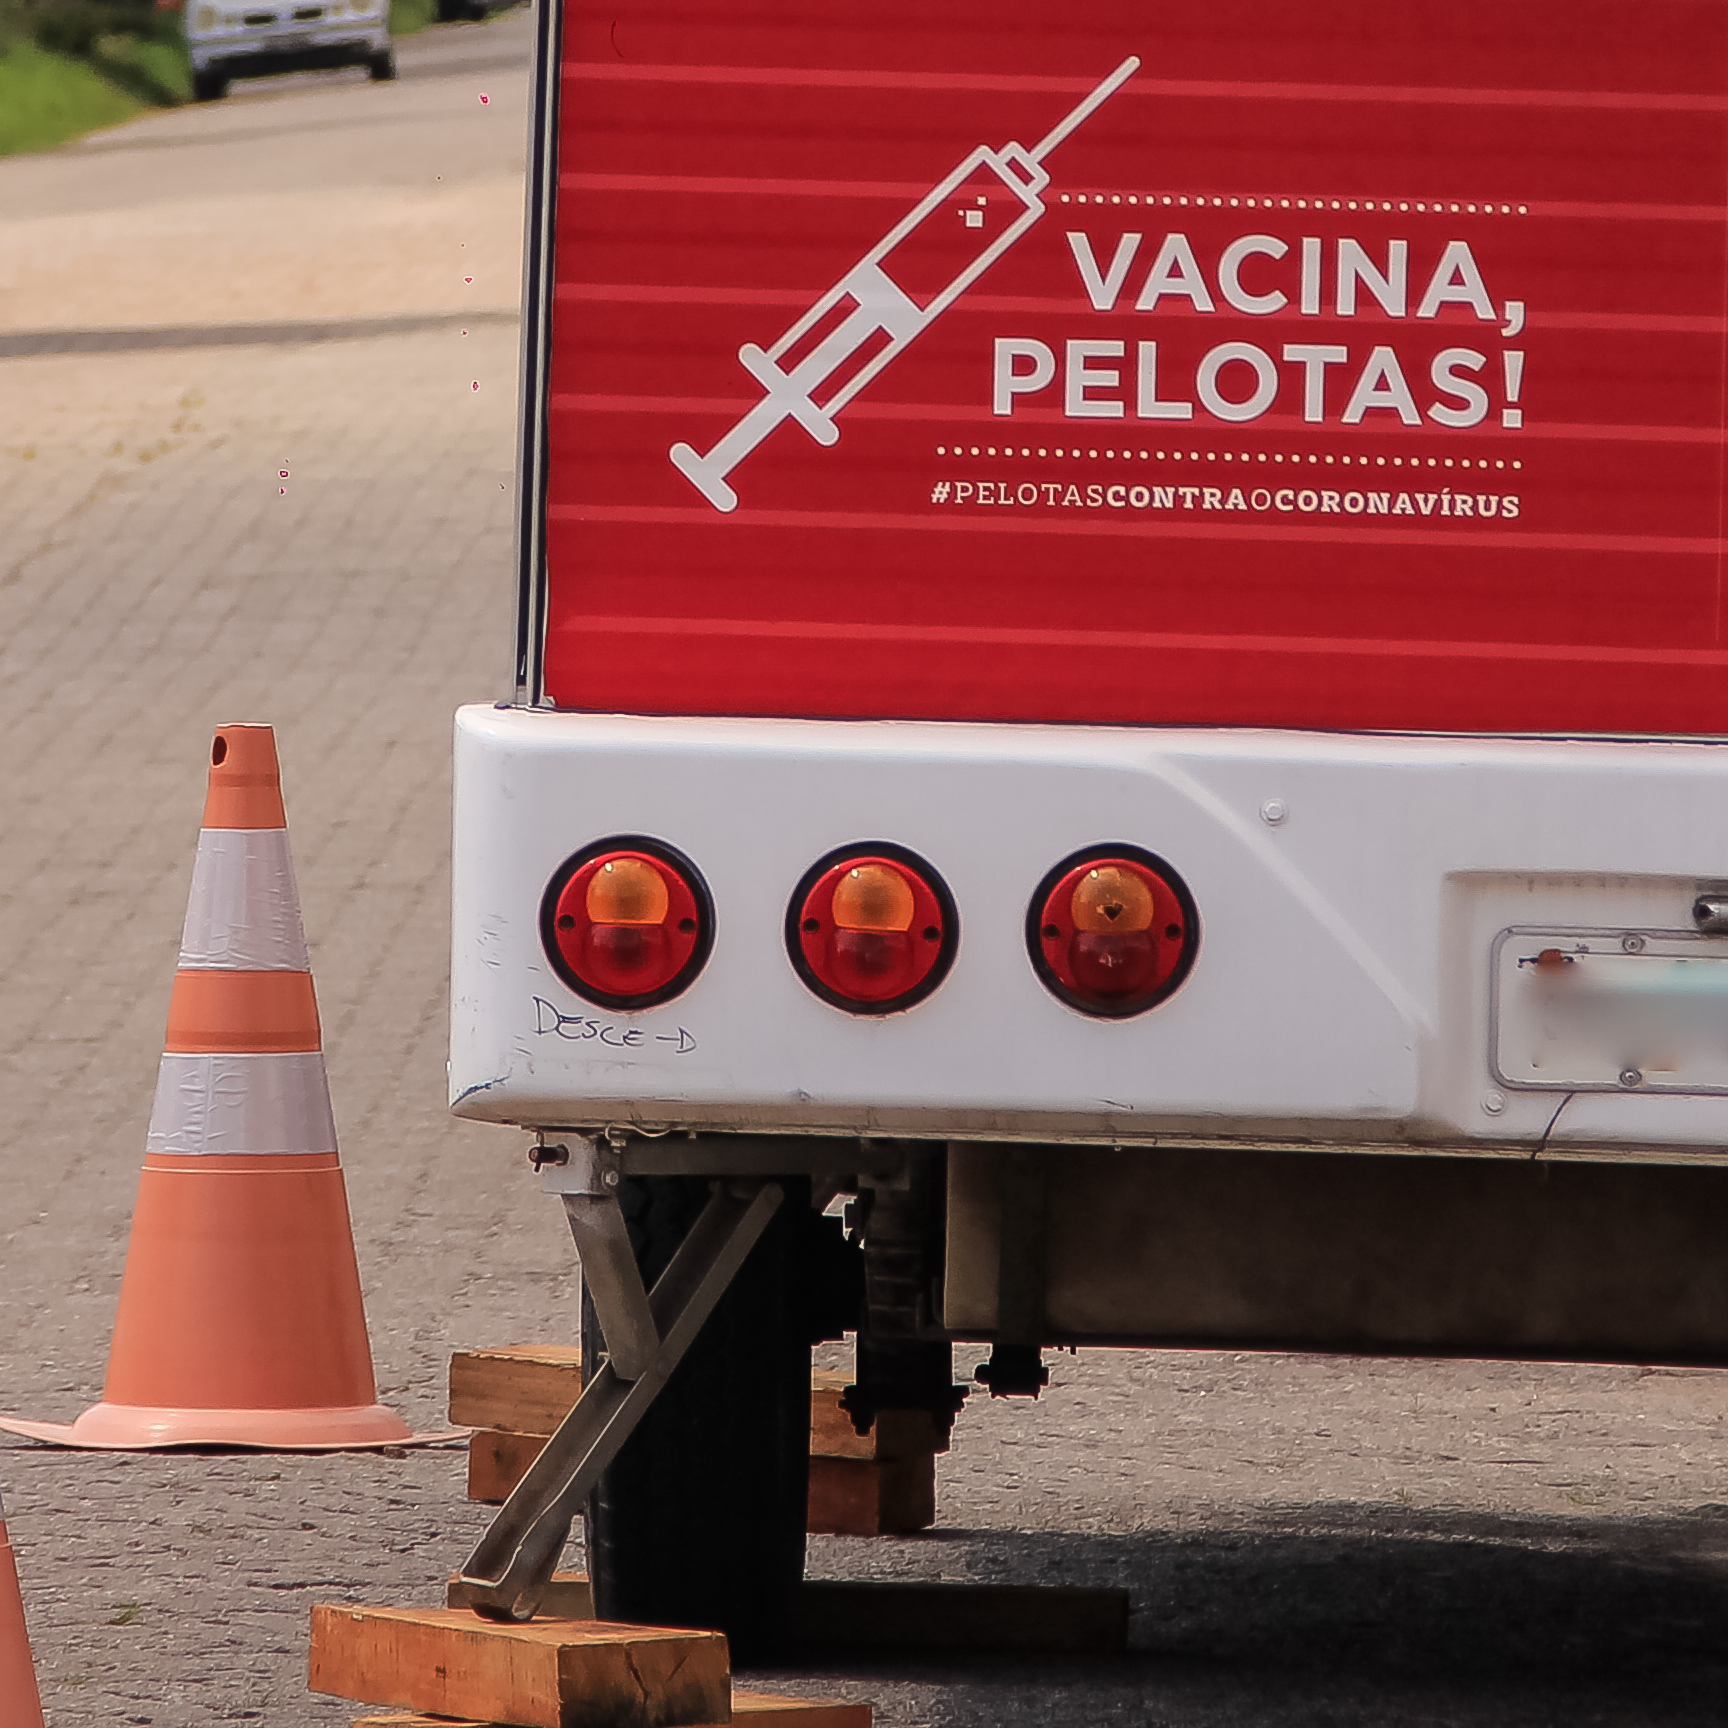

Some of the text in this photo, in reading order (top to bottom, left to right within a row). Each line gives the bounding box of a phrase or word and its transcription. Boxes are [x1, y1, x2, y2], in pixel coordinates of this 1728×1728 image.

[1066, 231, 1525, 337] VACINA,
[993, 337, 1525, 429] PELOTAS!
[930, 481, 1519, 518] #PELOTASCONTRAOCORONAVÍRUS
